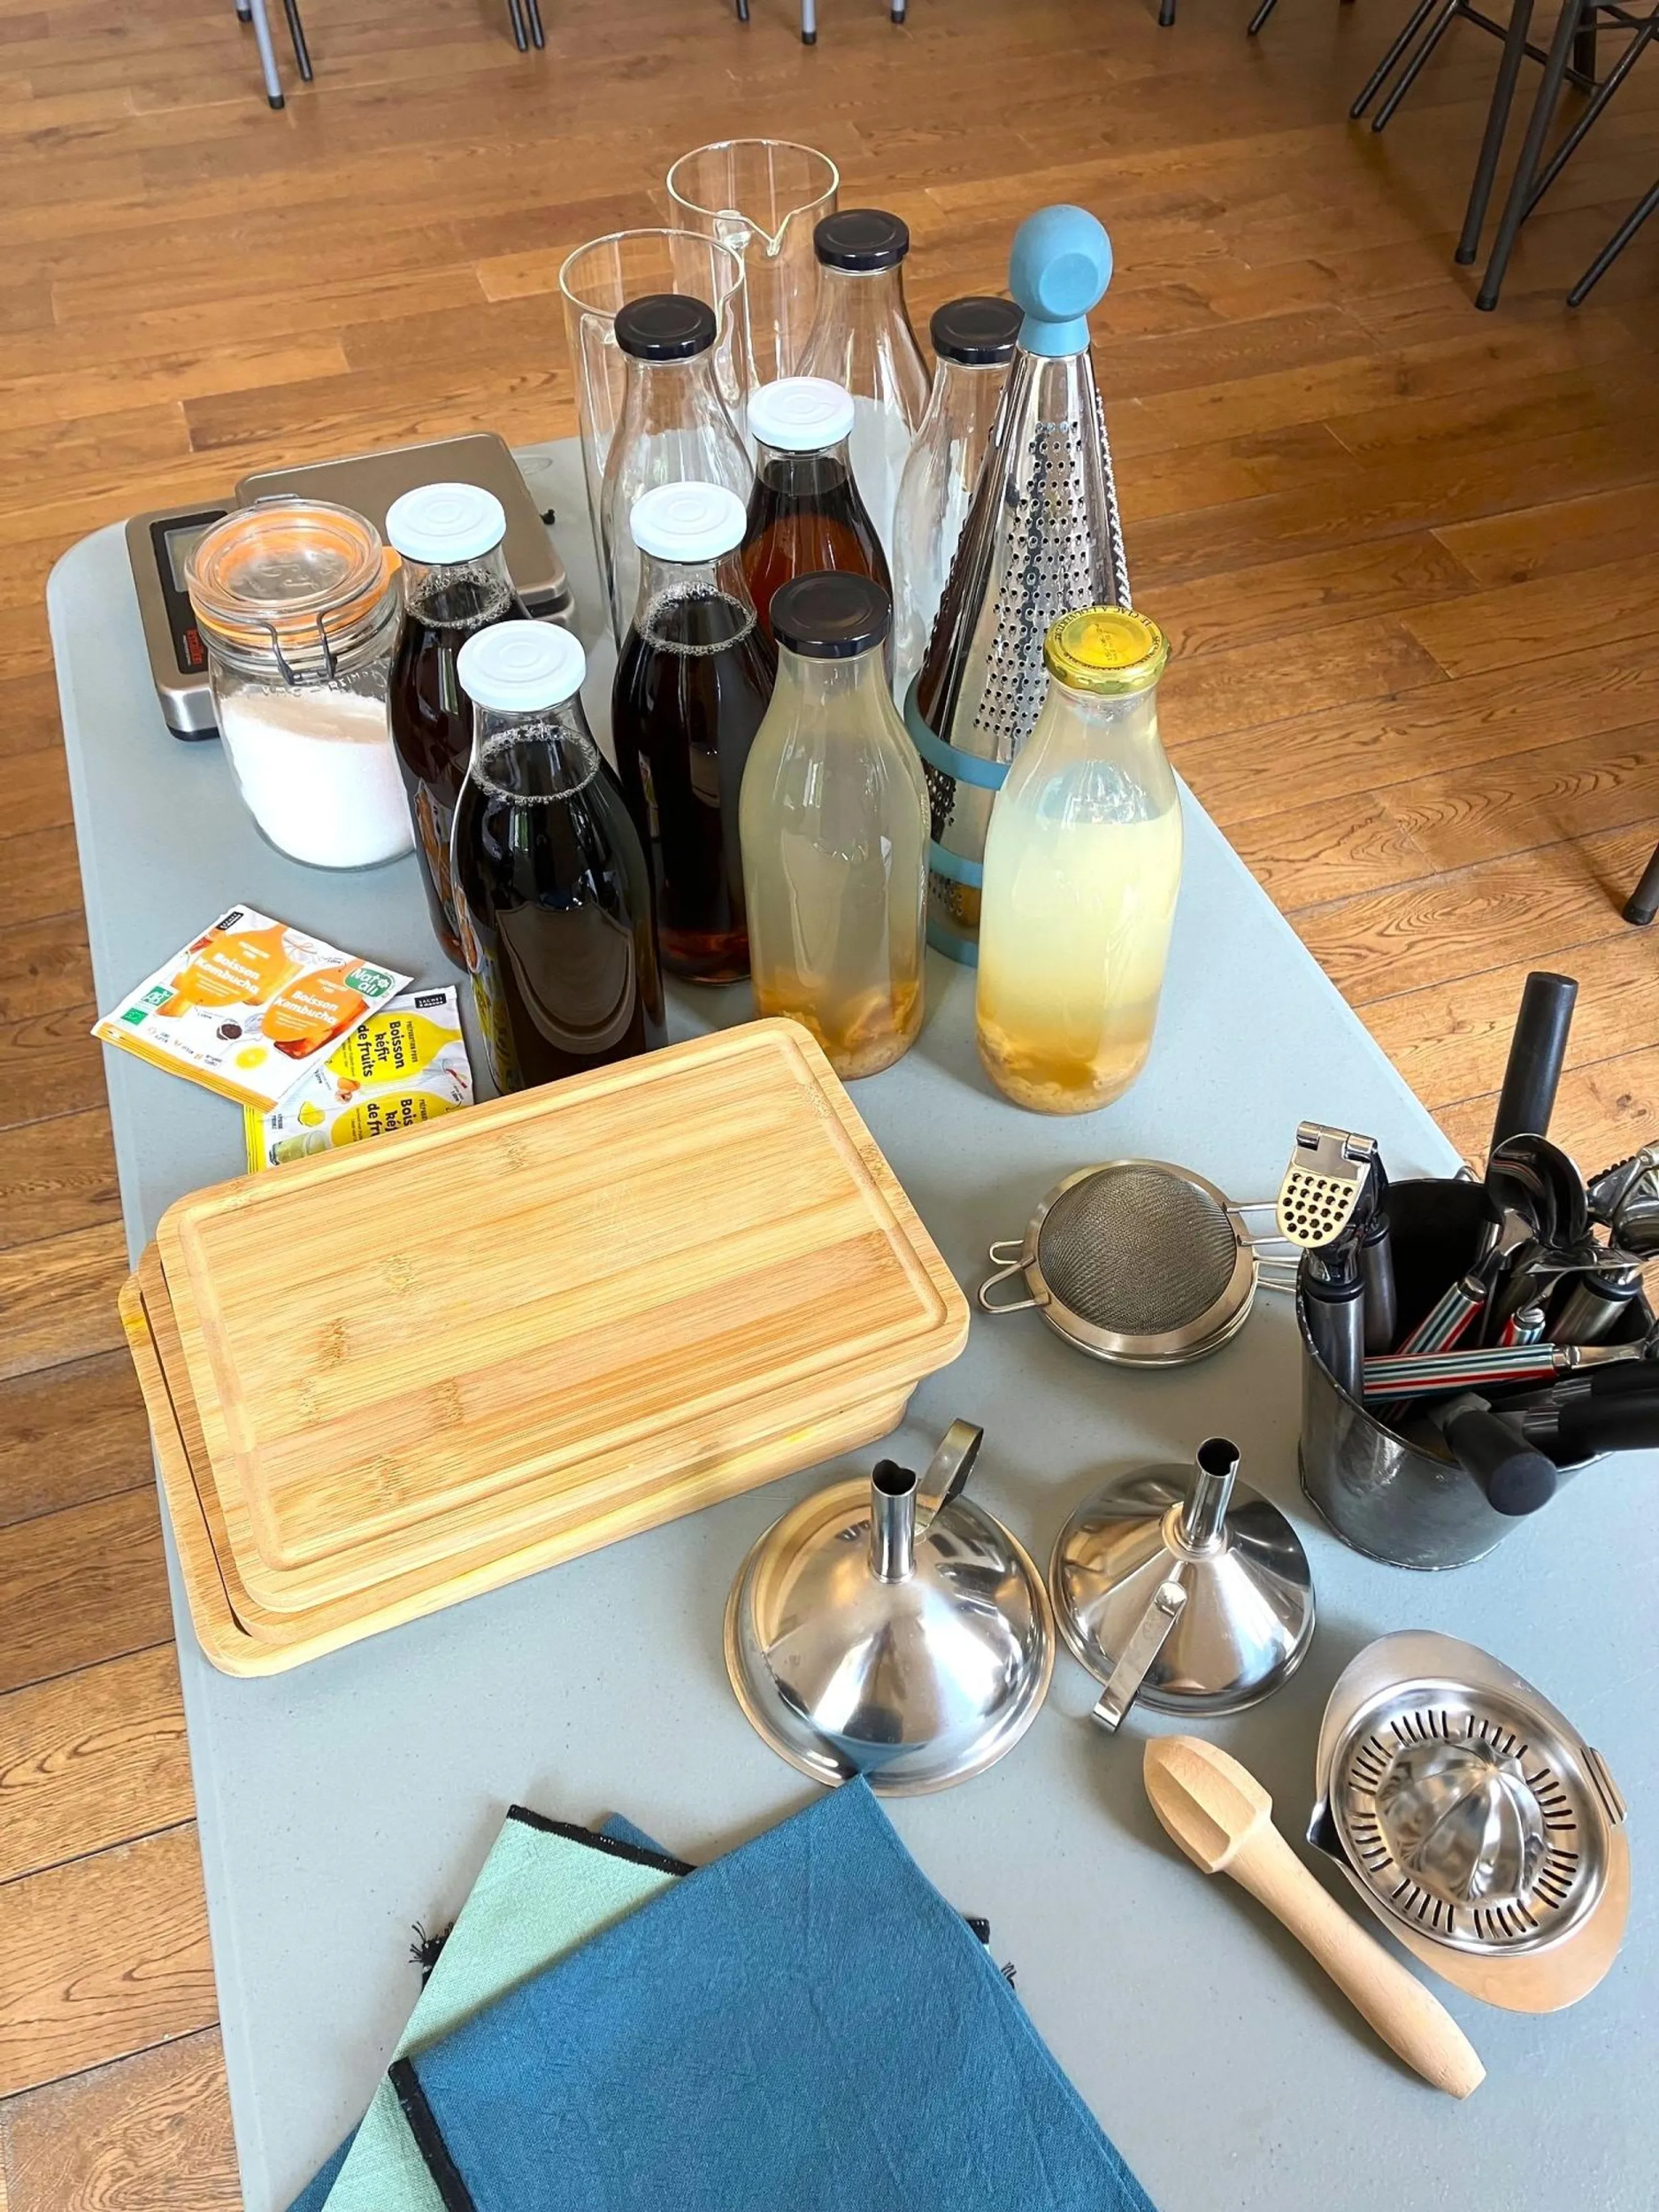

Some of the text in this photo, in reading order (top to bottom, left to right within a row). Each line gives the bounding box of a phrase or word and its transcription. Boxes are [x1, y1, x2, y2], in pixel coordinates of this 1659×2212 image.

[1117, 607, 1140, 618] CLAC
[194, 956, 260, 995] Kombucha
[212, 953, 260, 980] Boisson
[273, 996, 340, 1025] Kombucha
[291, 990, 339, 1012] Boisson
[357, 1025, 375, 1078] de fruits
[374, 1032, 390, 1062] kéfir
[389, 1021, 405, 1069] Boisson
[366, 1103, 380, 1119] de
